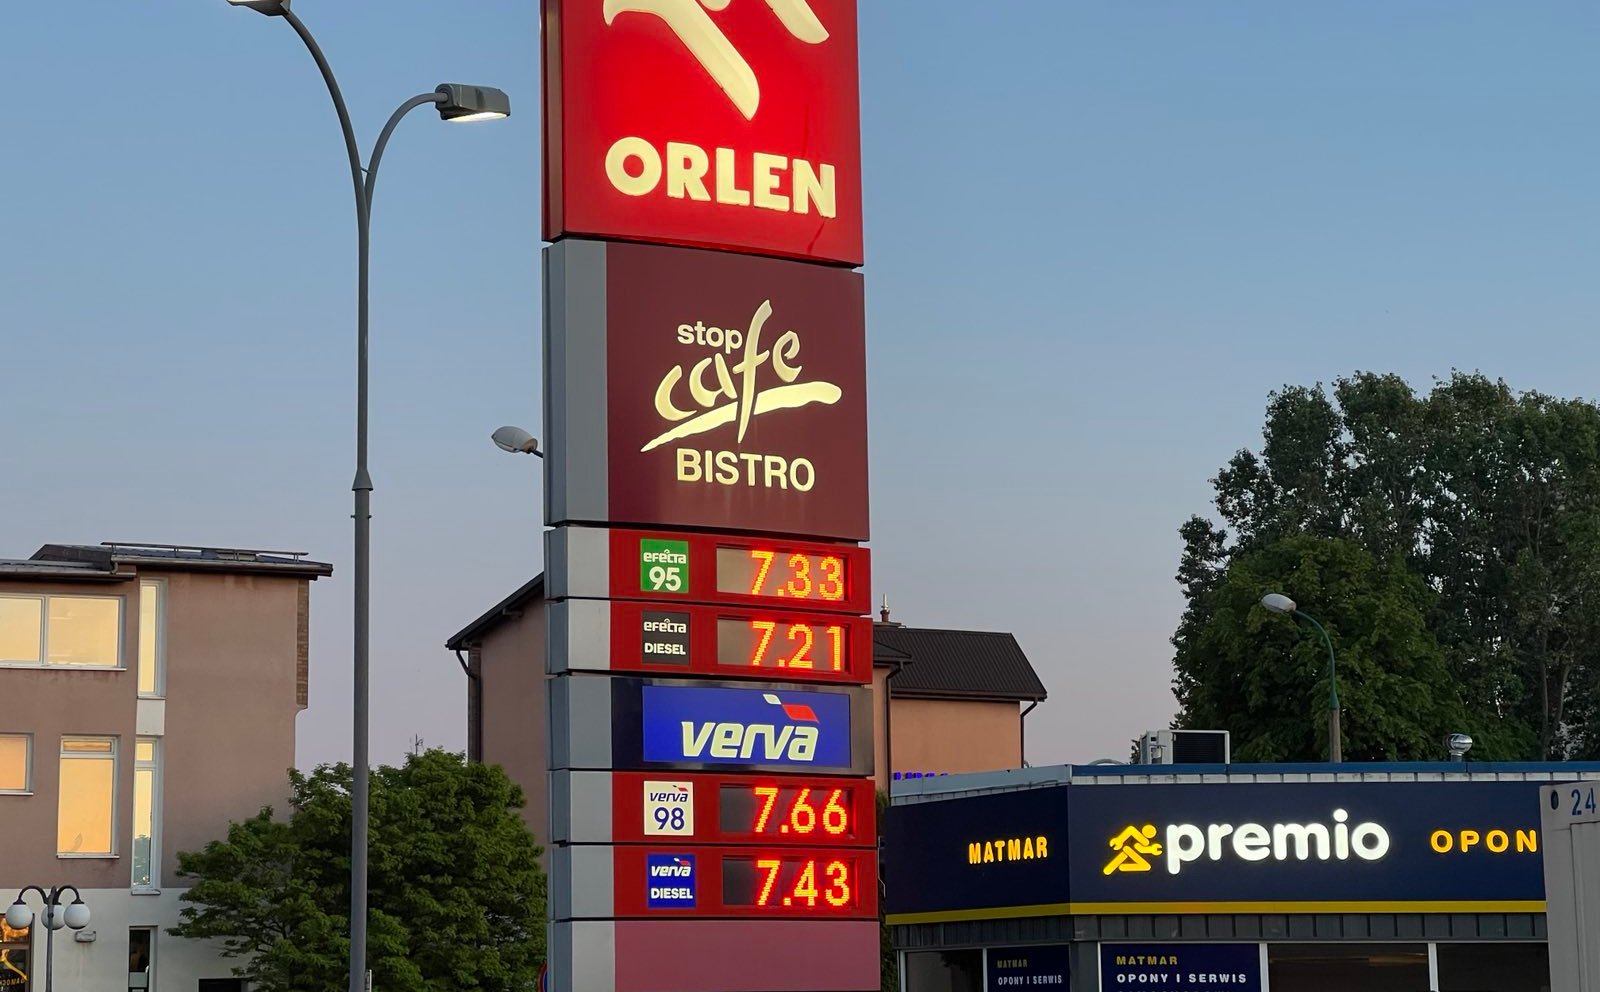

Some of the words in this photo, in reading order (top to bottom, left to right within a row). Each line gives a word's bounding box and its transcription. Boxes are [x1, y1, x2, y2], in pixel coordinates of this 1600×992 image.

[604, 136, 837, 219] ORLEN
[677, 320, 743, 354] stop
[654, 299, 803, 444] cafe
[676, 447, 816, 492] BISTRO
[648, 566, 682, 591] 95
[752, 550, 844, 600] 7.33
[644, 642, 687, 655] DIESEL
[752, 620, 841, 671] 7.21
[681, 721, 819, 761] verva
[649, 792, 689, 803] verva
[755, 787, 848, 834] 7.66
[653, 807, 685, 831] 98
[968, 836, 1049, 865] MATMAR
[1165, 808, 1390, 875] premio
[650, 865, 692, 877] verva
[757, 860, 850, 906] 7.43
[650, 887, 694, 899] DIESEL
[1116, 956, 1178, 966] MATMAR
[997, 975, 1024, 986] OPONY
[1032, 974, 1063, 985] SERWIS
[1116, 973, 1168, 983] OPONY
[1175, 973, 1180, 983] I
[1188, 973, 1247, 983] SERWIS
